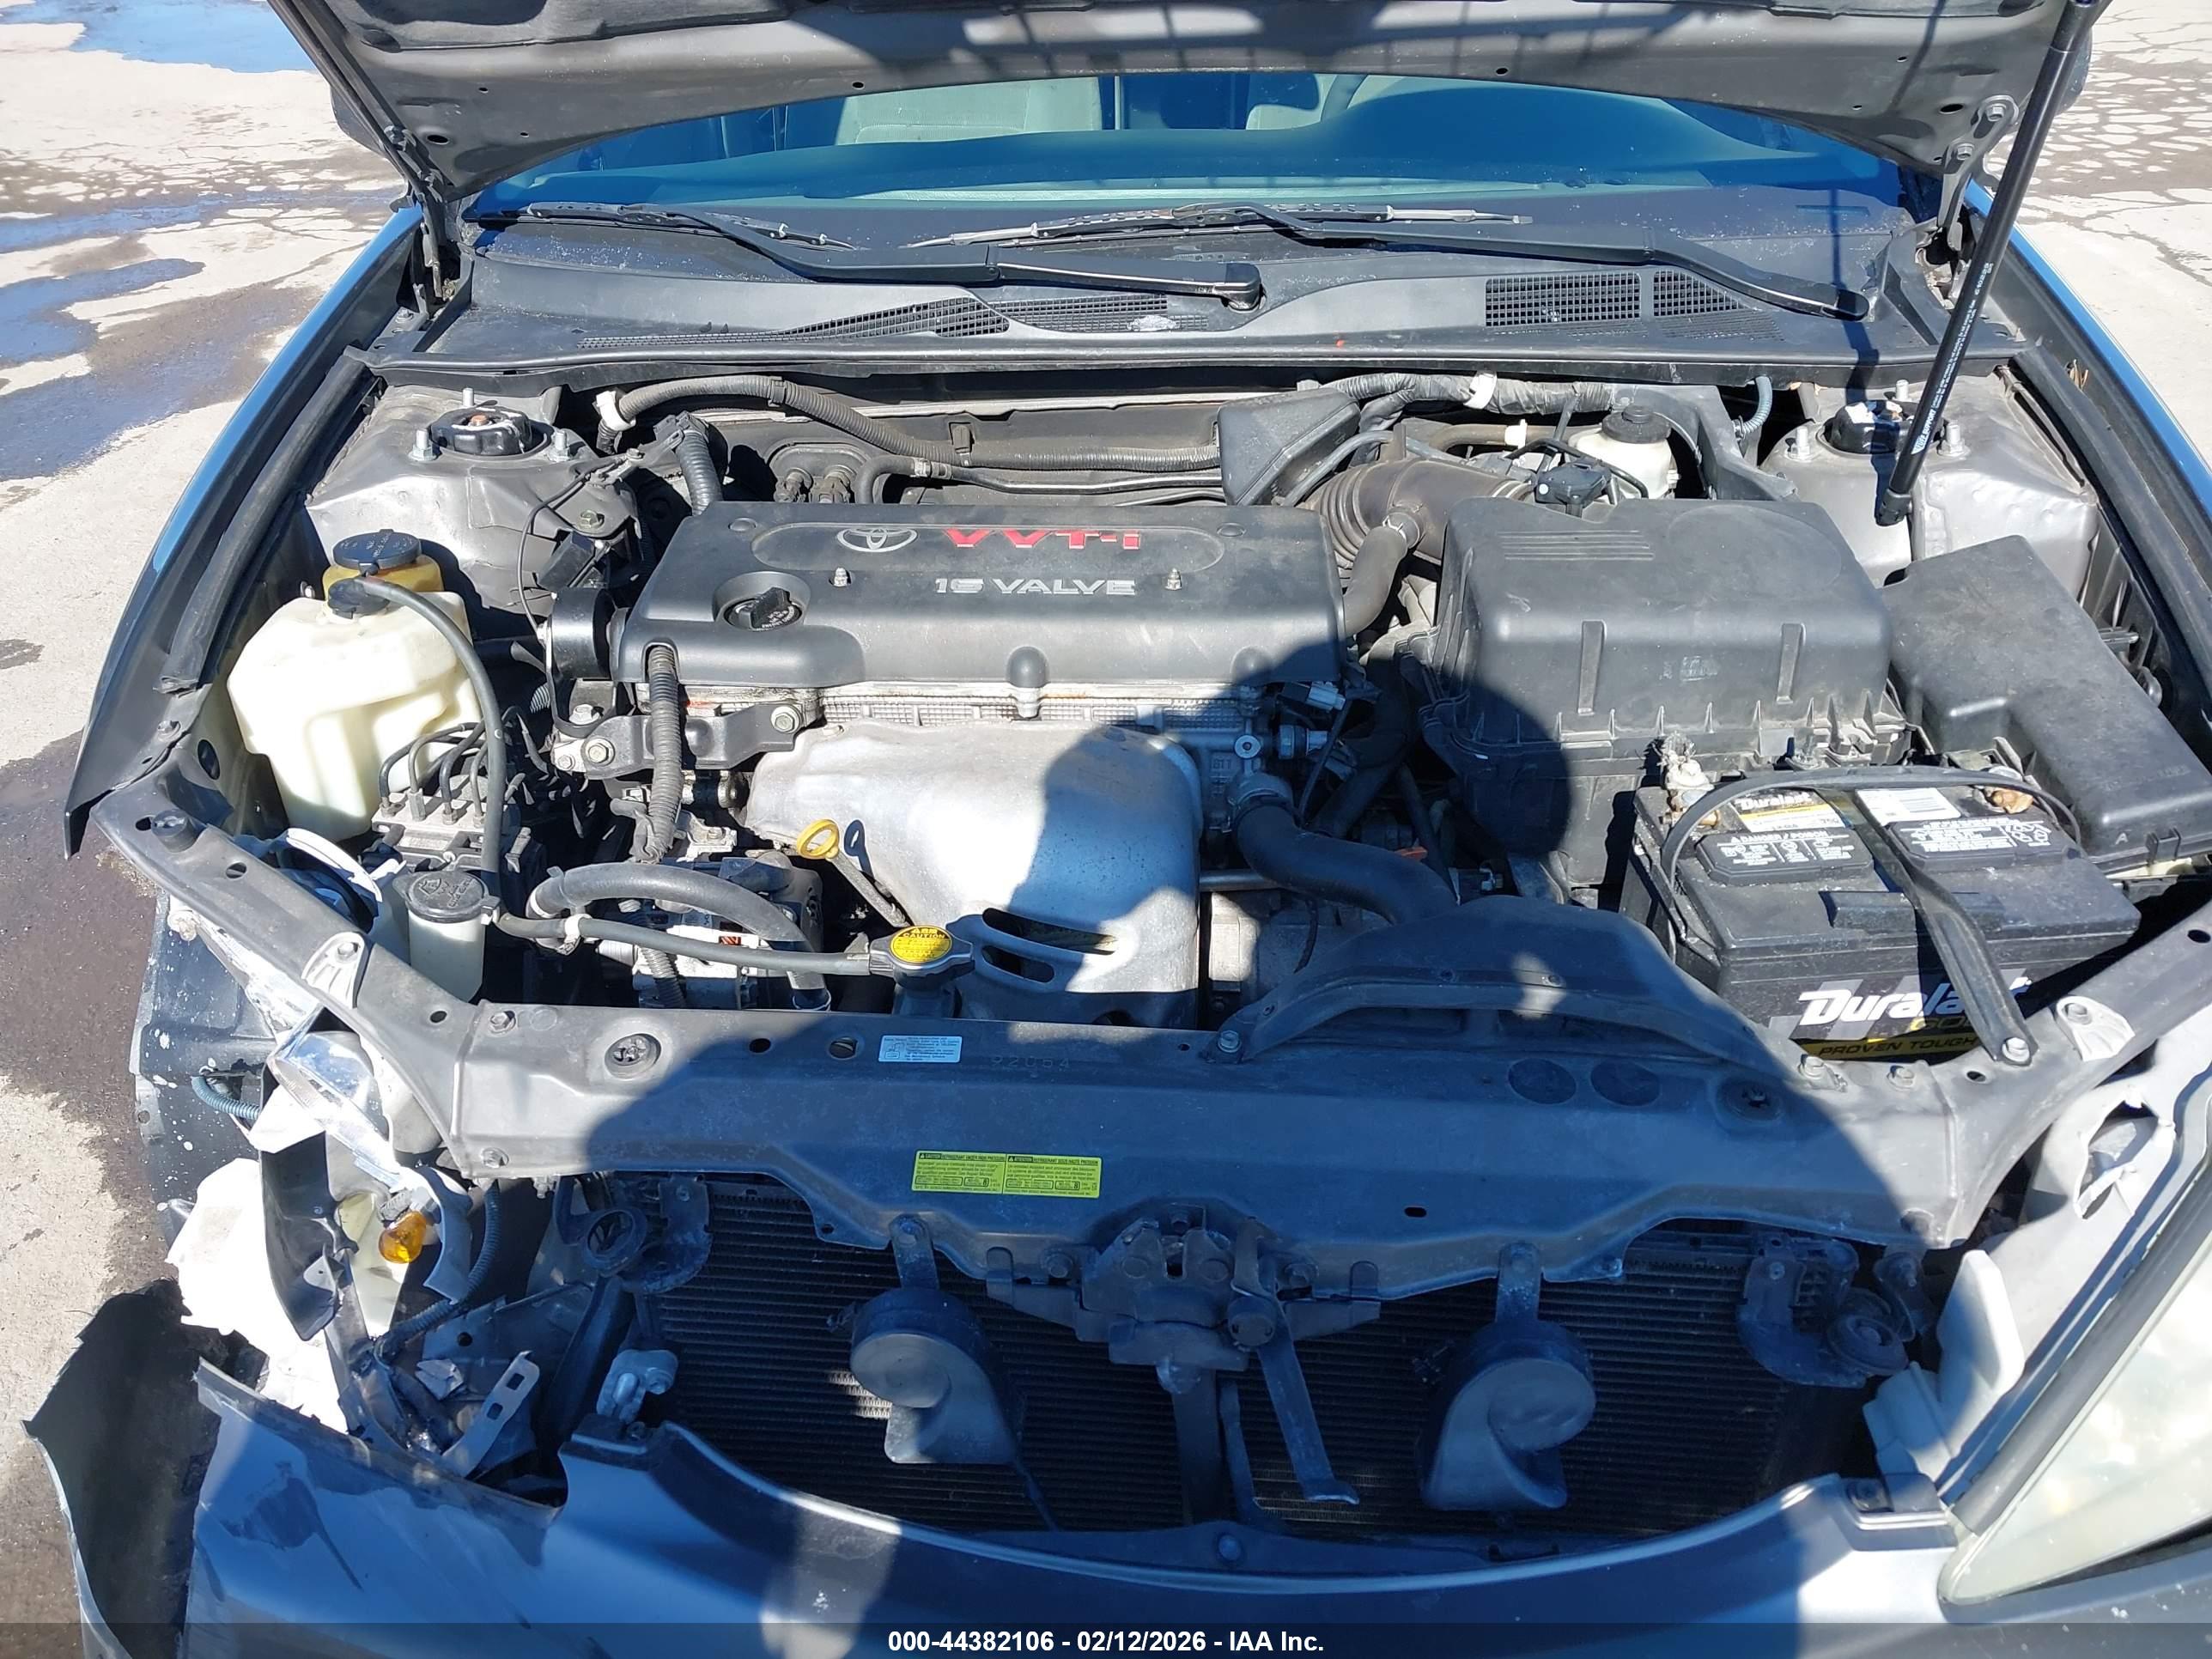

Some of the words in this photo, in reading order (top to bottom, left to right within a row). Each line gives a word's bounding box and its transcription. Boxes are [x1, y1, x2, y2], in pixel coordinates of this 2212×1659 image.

[1922, 409, 1936, 434] SUPPORT
[935, 578, 984, 593] 16
[992, 579, 1135, 595] VALVE
[1820, 1042, 1902, 1055] PROVEN
[1910, 1036, 1975, 1051] TOUGH
